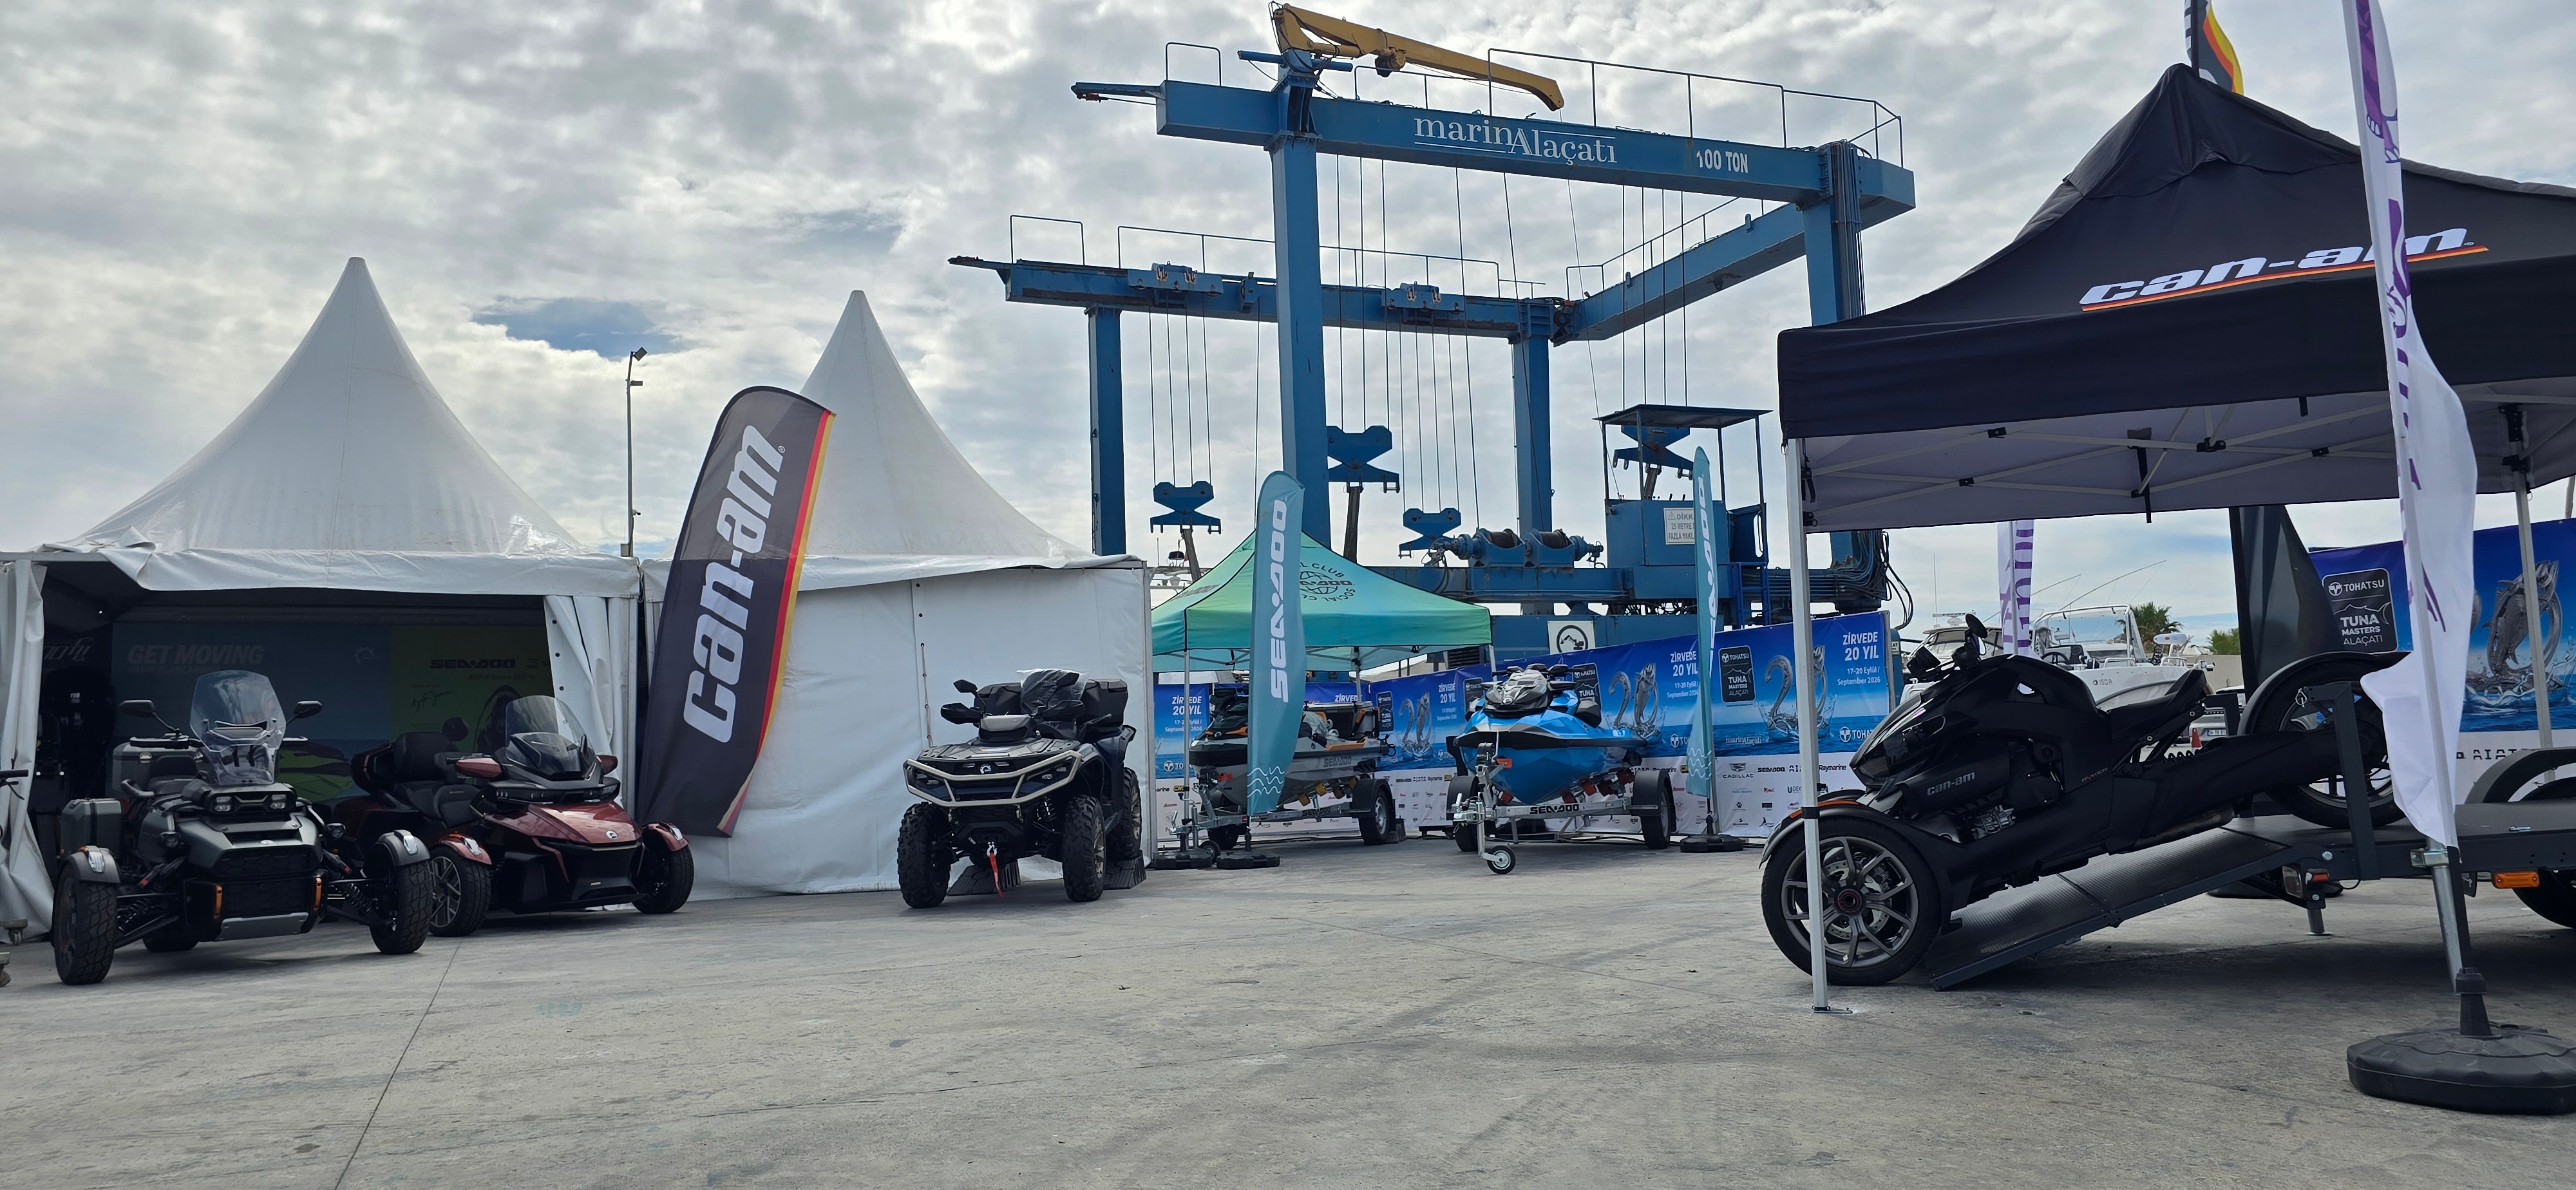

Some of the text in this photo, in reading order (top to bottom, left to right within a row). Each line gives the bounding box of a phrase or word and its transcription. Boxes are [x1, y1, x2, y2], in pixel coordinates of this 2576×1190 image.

[1696, 150, 1748, 173] 100 TON
[1311, 563, 1344, 578] CLUB
[2343, 580, 2385, 592] TOHATSU
[2340, 614, 2379, 627] TUNA
[2342, 626, 2381, 636] MASTERS
[1842, 632, 1878, 645] ZİRVEDE
[2343, 635, 2383, 646] ALAÇATI
[128, 644, 264, 664] GET MOVING
[1670, 650, 1697, 663] ZİRVEDE
[1844, 648, 1860, 661] 20
[1862, 645, 1879, 660] YIL
[1672, 663, 1698, 676] 20 YIL
[1728, 675, 1747, 684] TUNA
[1837, 677, 1866, 686] September
[1172, 695, 1202, 704] ZİREDE
[1335, 694, 1363, 702] ZİRVED
[1440, 694, 1448, 703] 20
[1173, 706, 1185, 715] 20
[1852, 730, 1873, 739] TOHA
[1927, 771, 1975, 795] can-am
